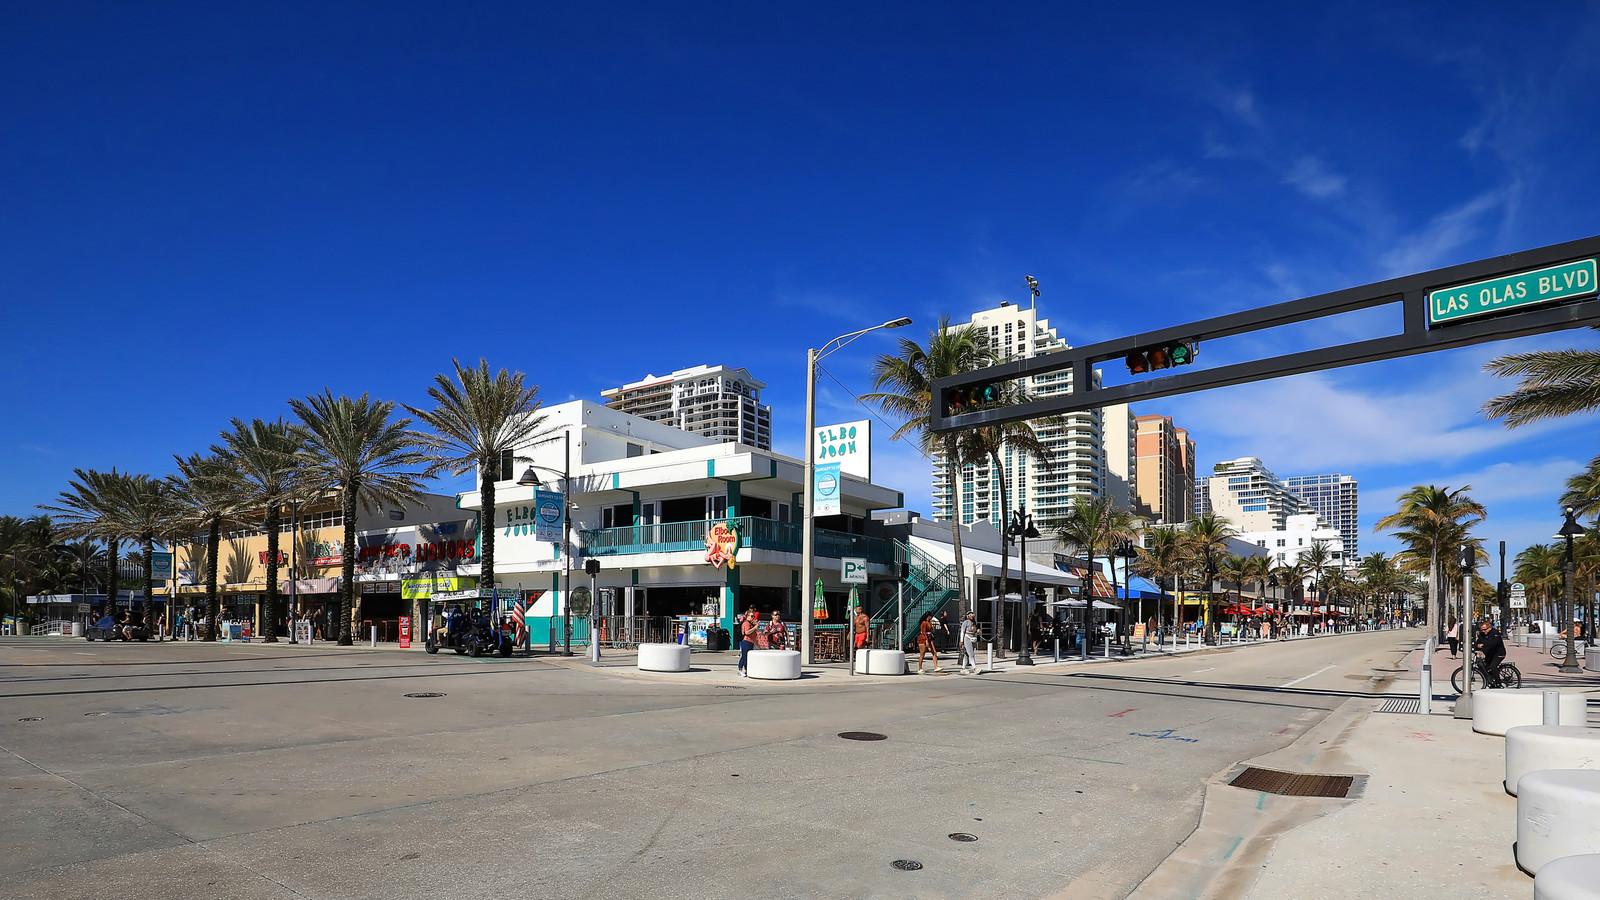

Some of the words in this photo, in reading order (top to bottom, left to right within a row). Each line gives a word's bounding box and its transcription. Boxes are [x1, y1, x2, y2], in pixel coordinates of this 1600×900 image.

[1436, 293, 1469, 316] LAS
[1479, 281, 1527, 306] OLAS
[1538, 269, 1589, 295] BLVD
[819, 426, 856, 444] ELBO
[819, 441, 856, 459] ROOM
[507, 506, 536, 522] ELBO
[504, 520, 536, 537] ROOM
[714, 526, 728, 535] Elbo
[718, 535, 736, 543] Room
[416, 539, 475, 562] LIQUORS
